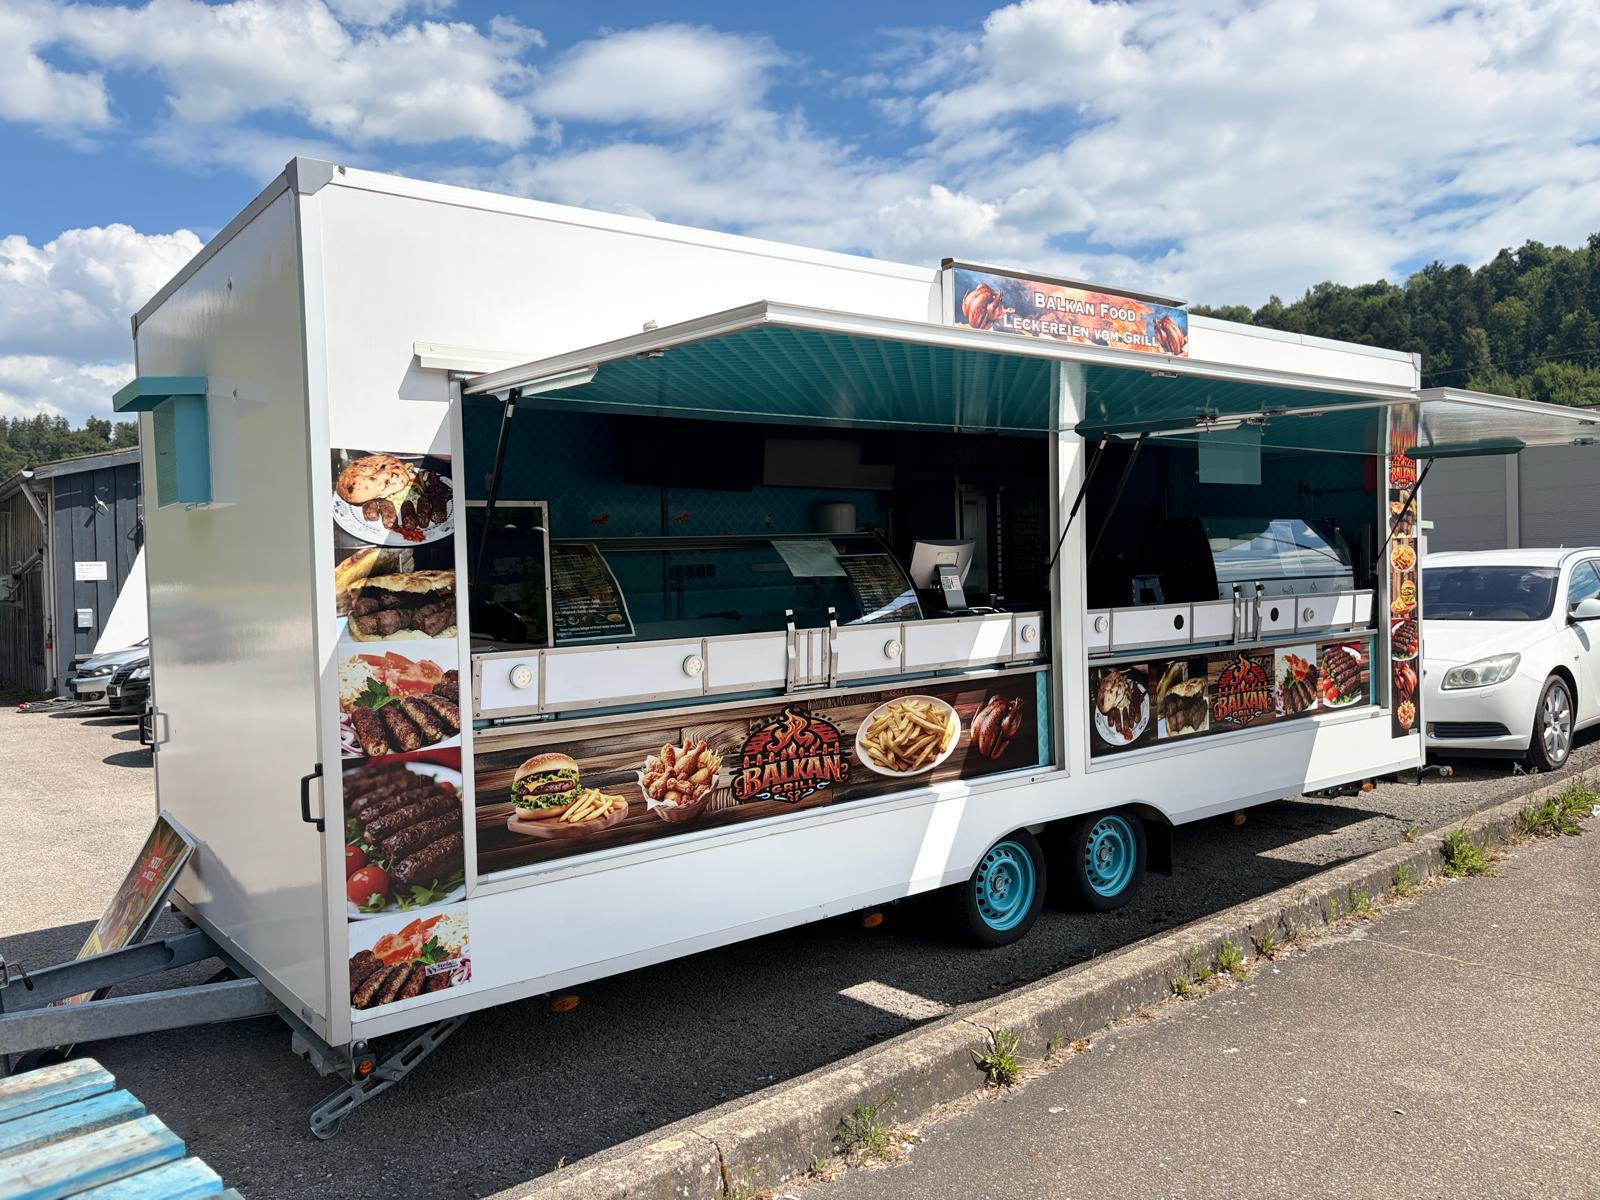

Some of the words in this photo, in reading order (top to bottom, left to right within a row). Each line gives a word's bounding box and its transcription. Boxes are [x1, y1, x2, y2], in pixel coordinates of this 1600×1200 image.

[1035, 292, 1095, 316] BALKAN
[1100, 304, 1136, 323] FOOD
[1003, 314, 1089, 338] LECKEREIEN
[1123, 332, 1159, 348] GRILL
[1214, 691, 1269, 720] BALKAN
[1232, 708, 1254, 718] GRILL
[735, 754, 844, 800] BALKAN
[771, 779, 816, 793] GRILL
